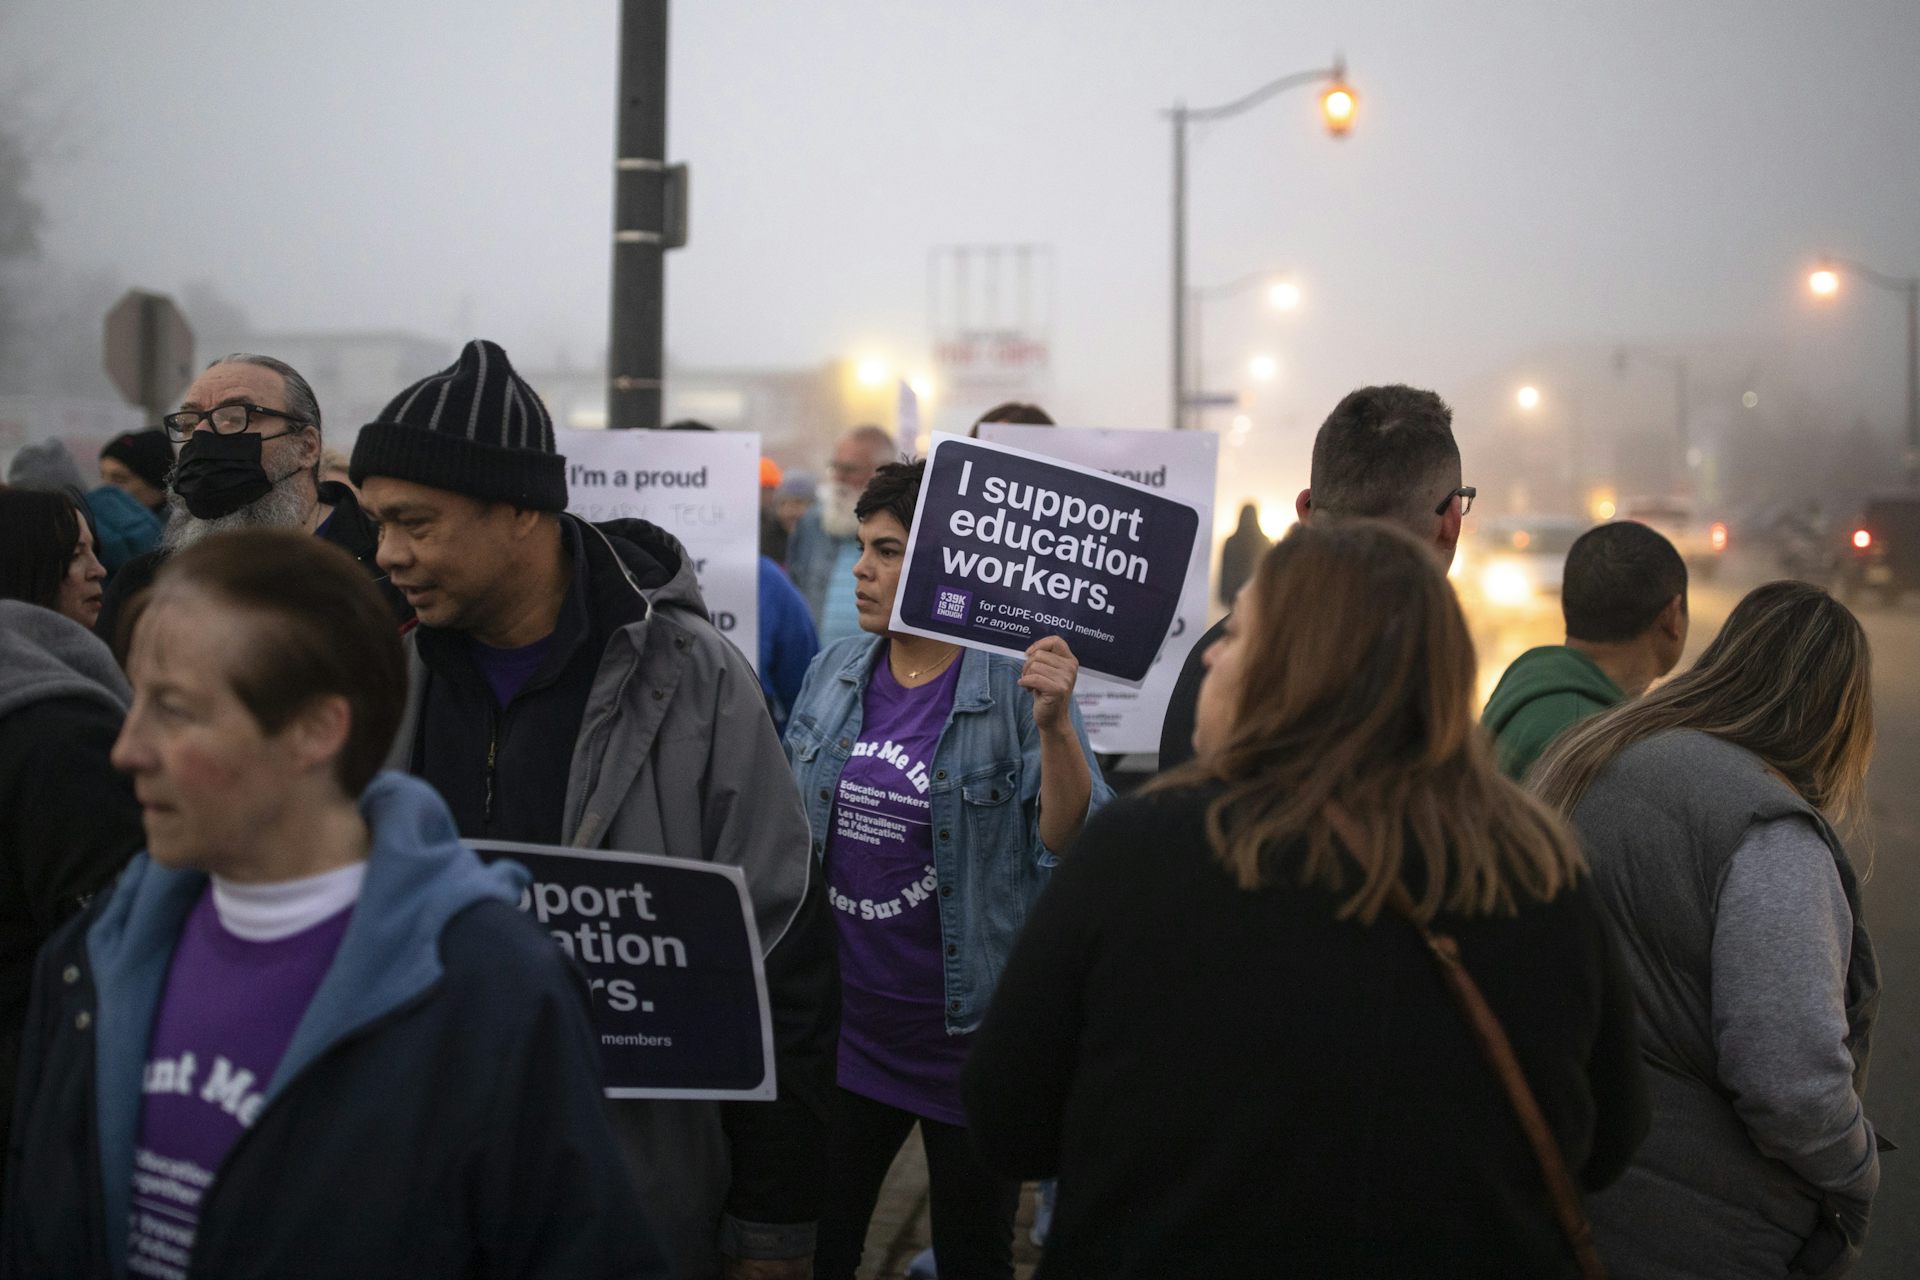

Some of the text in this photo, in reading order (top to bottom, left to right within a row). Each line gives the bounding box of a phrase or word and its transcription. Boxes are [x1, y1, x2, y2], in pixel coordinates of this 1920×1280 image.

[613, 470, 628, 487] a
[635, 465, 708, 492] proud
[957, 460, 1144, 542] I support
[949, 508, 1149, 584] education
[942, 546, 1116, 615] workers.
[938, 600, 965, 613] IS NOT
[940, 591, 966, 606] $39K
[937, 608, 963, 619] ENOUGH
[979, 600, 1115, 643] for CUPE-OSBCU members
[975, 615, 1032, 635] or anyone.
[876, 740, 910, 770] Me
[839, 789, 880, 807] Together
[840, 780, 930, 809] Education Workers
[837, 808, 906, 833] Les travailleurs
[837, 818, 850, 828] de
[837, 828, 880, 845] solidaires
[859, 898, 902, 920] Sur
[601, 1032, 672, 1047] members
